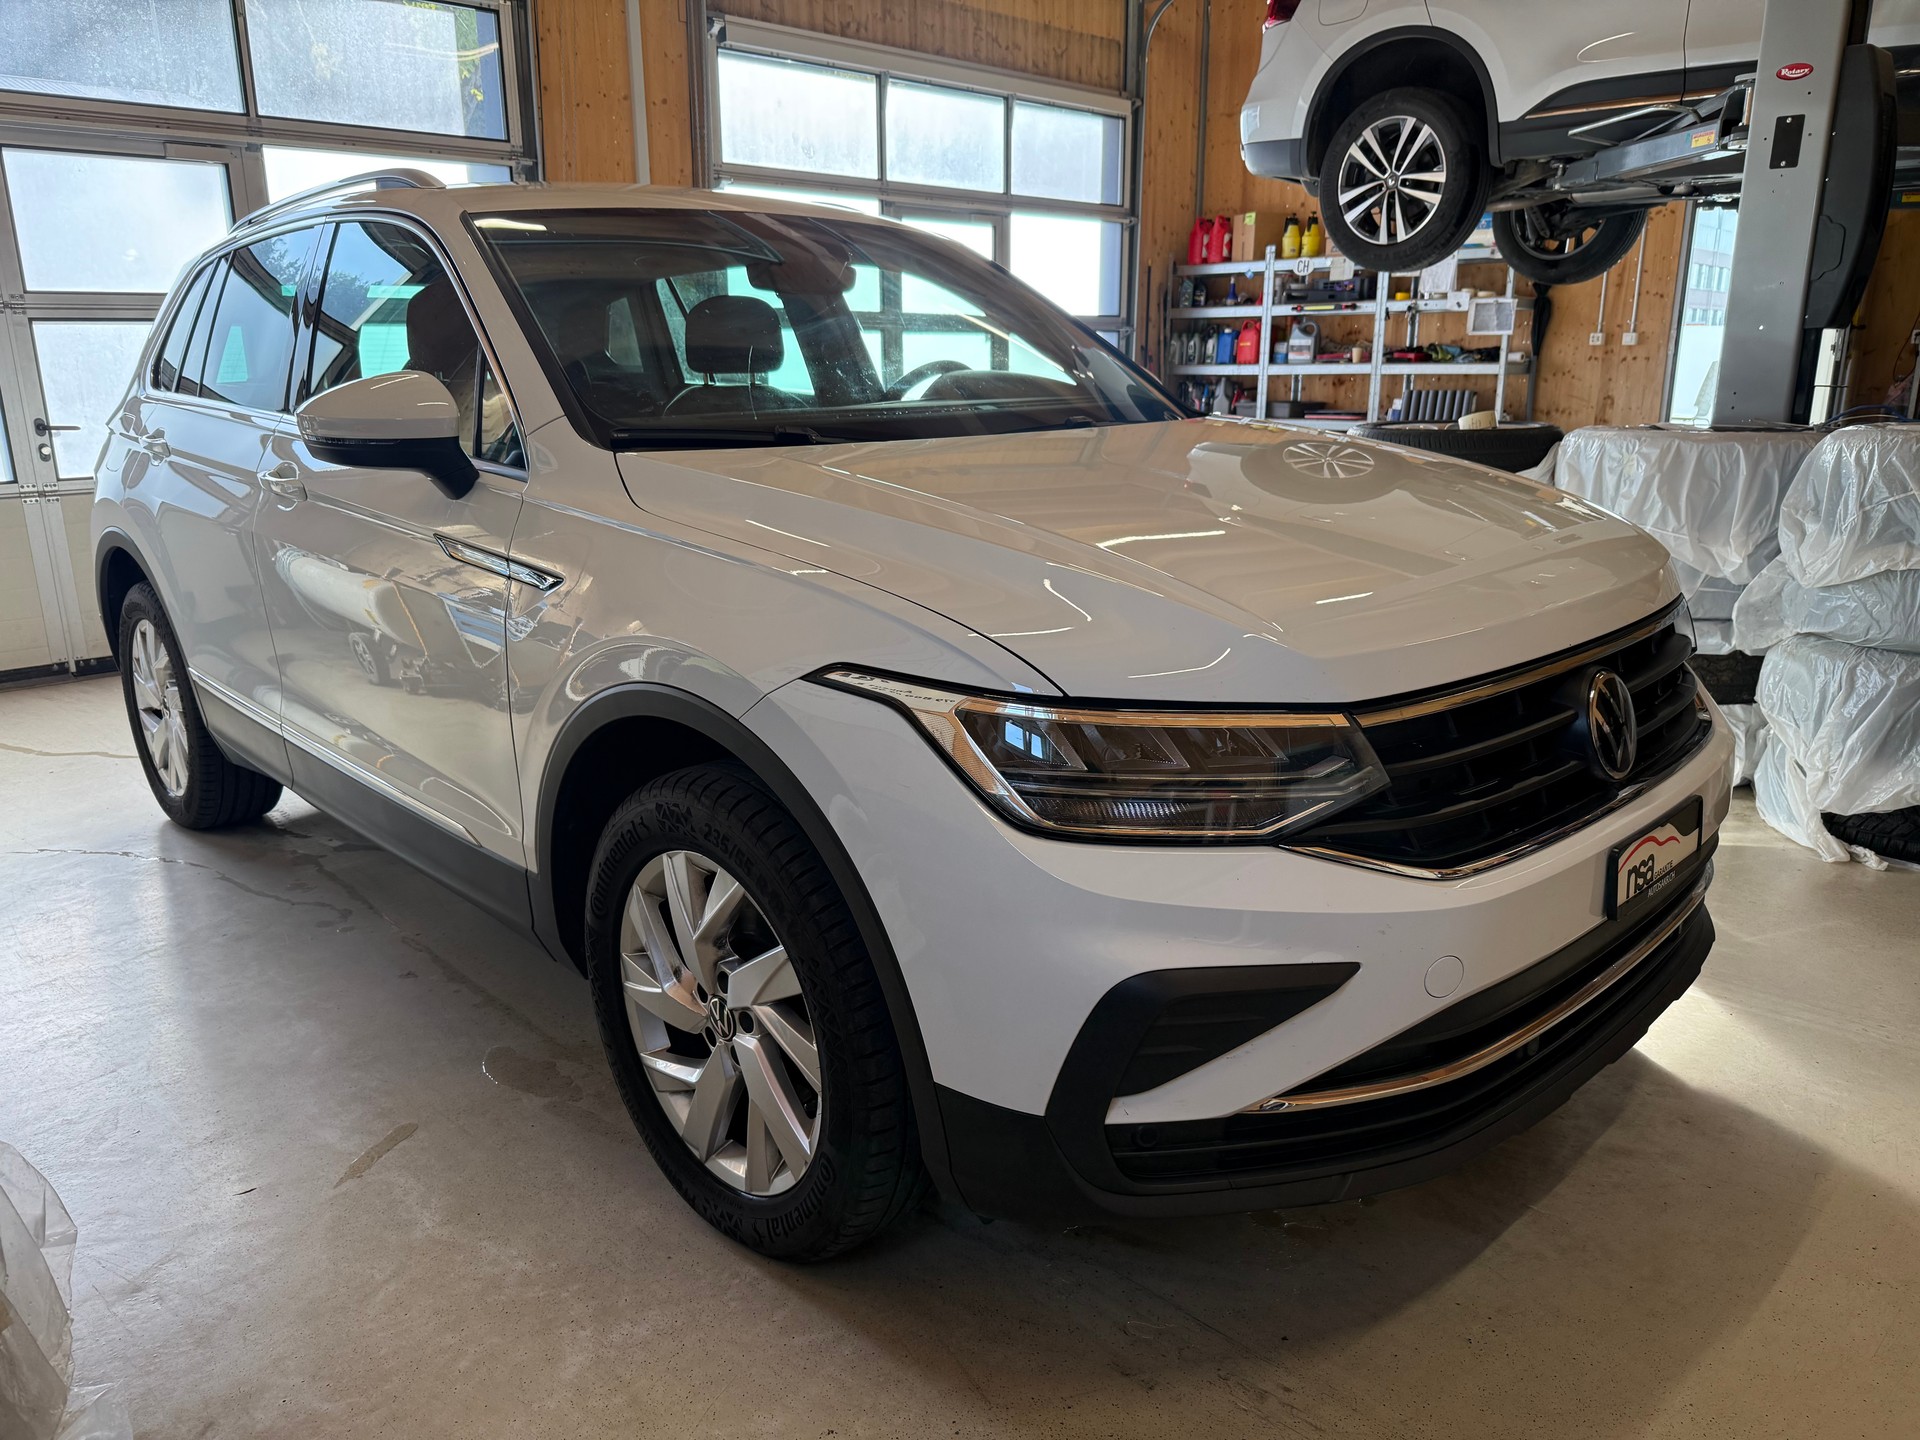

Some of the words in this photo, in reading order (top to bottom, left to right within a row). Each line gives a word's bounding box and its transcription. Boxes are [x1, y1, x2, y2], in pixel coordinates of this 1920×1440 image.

[1781, 67, 1811, 78] Rotary
[1296, 259, 1311, 274] CH
[591, 820, 641, 919] Continental
[1627, 853, 1655, 898] nsa
[766, 1151, 838, 1245] Continental
